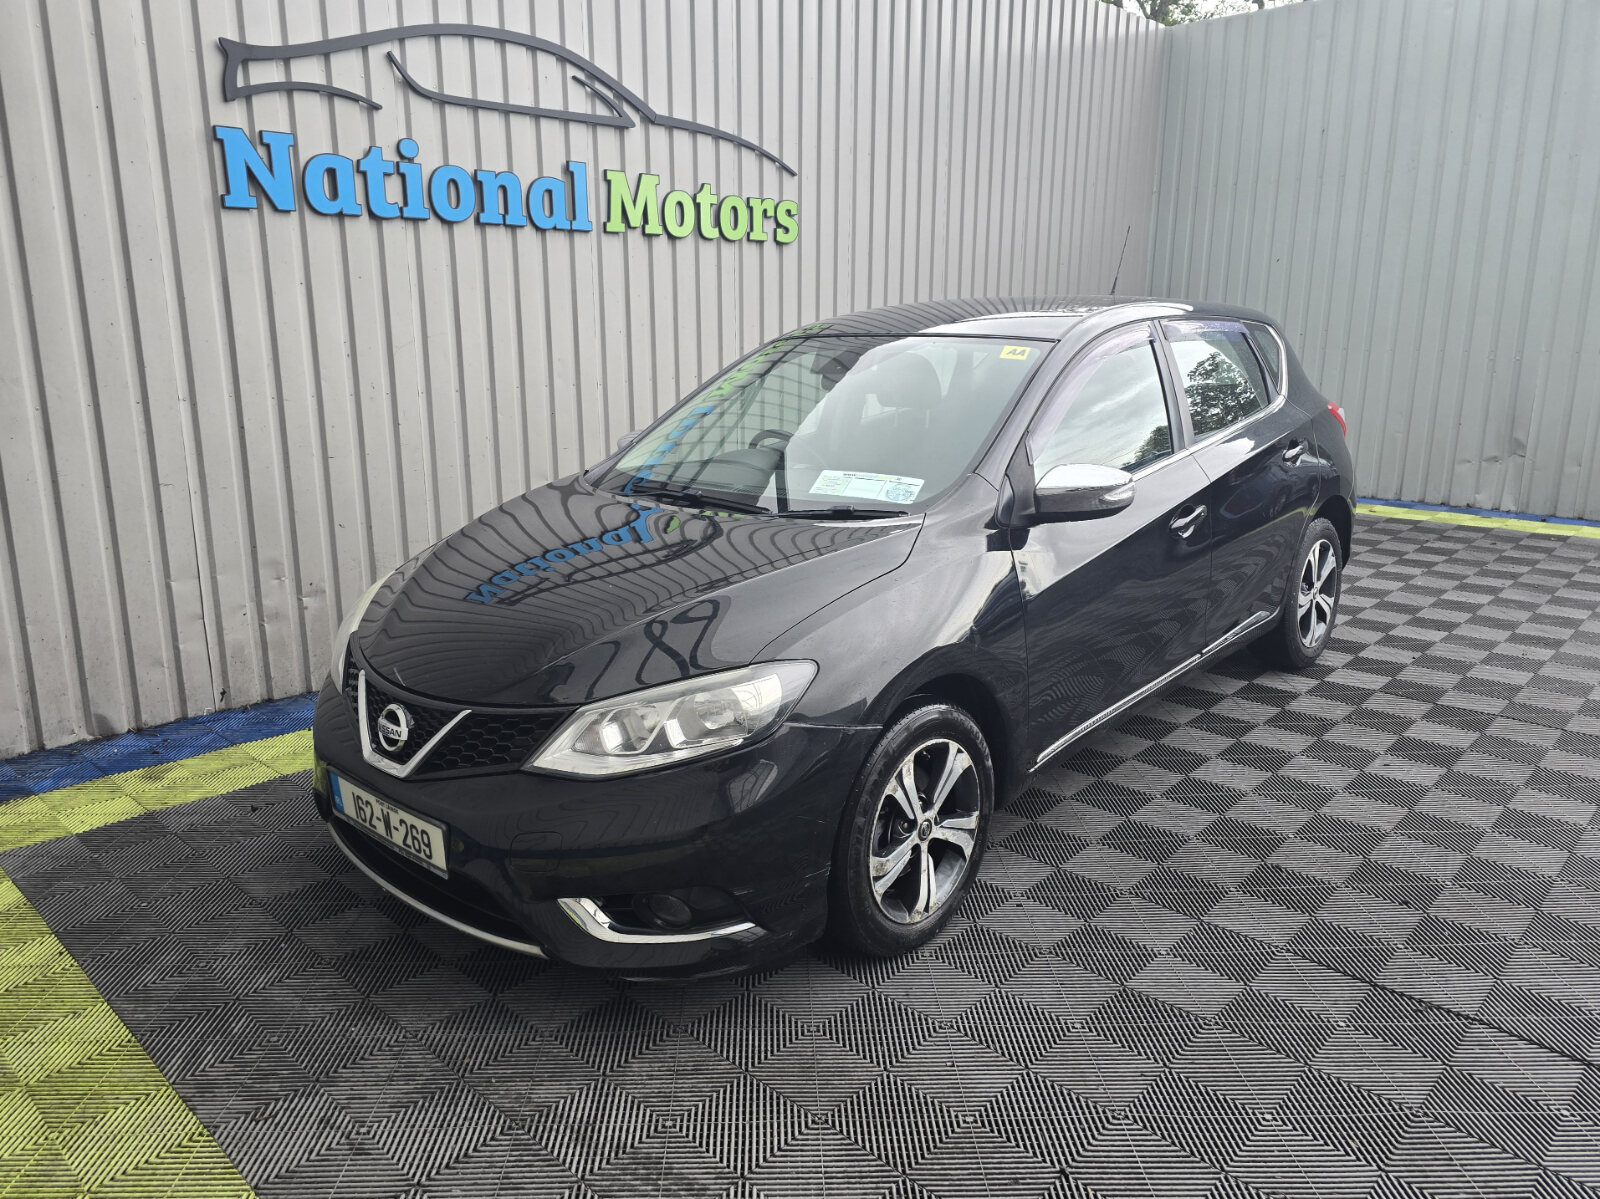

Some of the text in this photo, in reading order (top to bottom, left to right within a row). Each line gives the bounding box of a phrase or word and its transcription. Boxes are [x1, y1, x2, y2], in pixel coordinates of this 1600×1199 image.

[213, 125, 799, 245] National Motors
[1006, 348, 1027, 357] AA
[352, 791, 433, 860] 162-W-269
